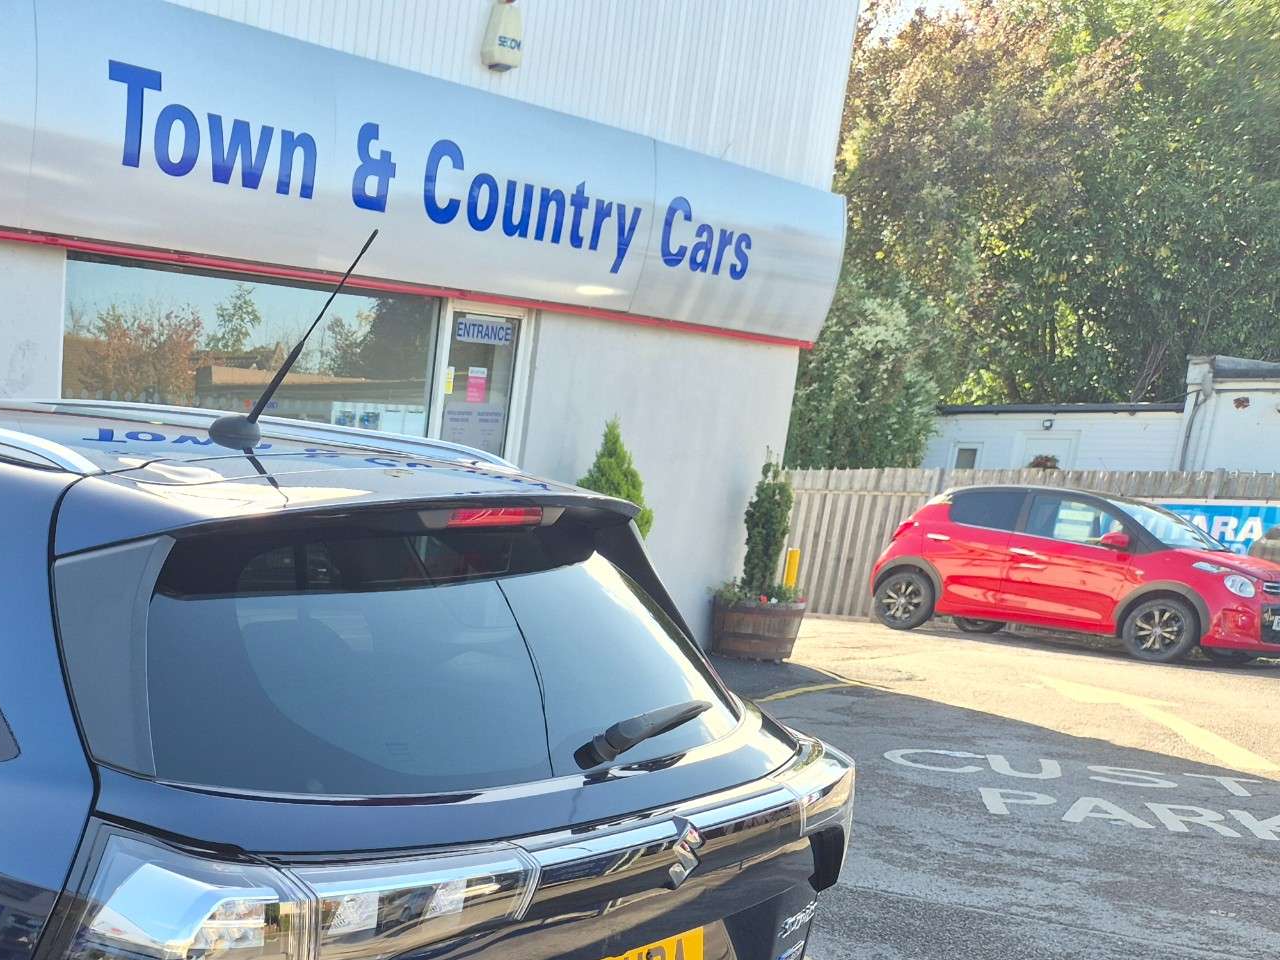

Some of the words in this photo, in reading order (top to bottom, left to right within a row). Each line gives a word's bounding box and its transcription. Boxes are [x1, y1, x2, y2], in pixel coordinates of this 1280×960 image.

[108, 59, 318, 200] Town
[352, 121, 396, 213] &
[424, 139, 642, 274] Country
[660, 196, 752, 280] Cars
[456, 321, 513, 342] ENTRANCE
[978, 786, 1280, 841] PARK
